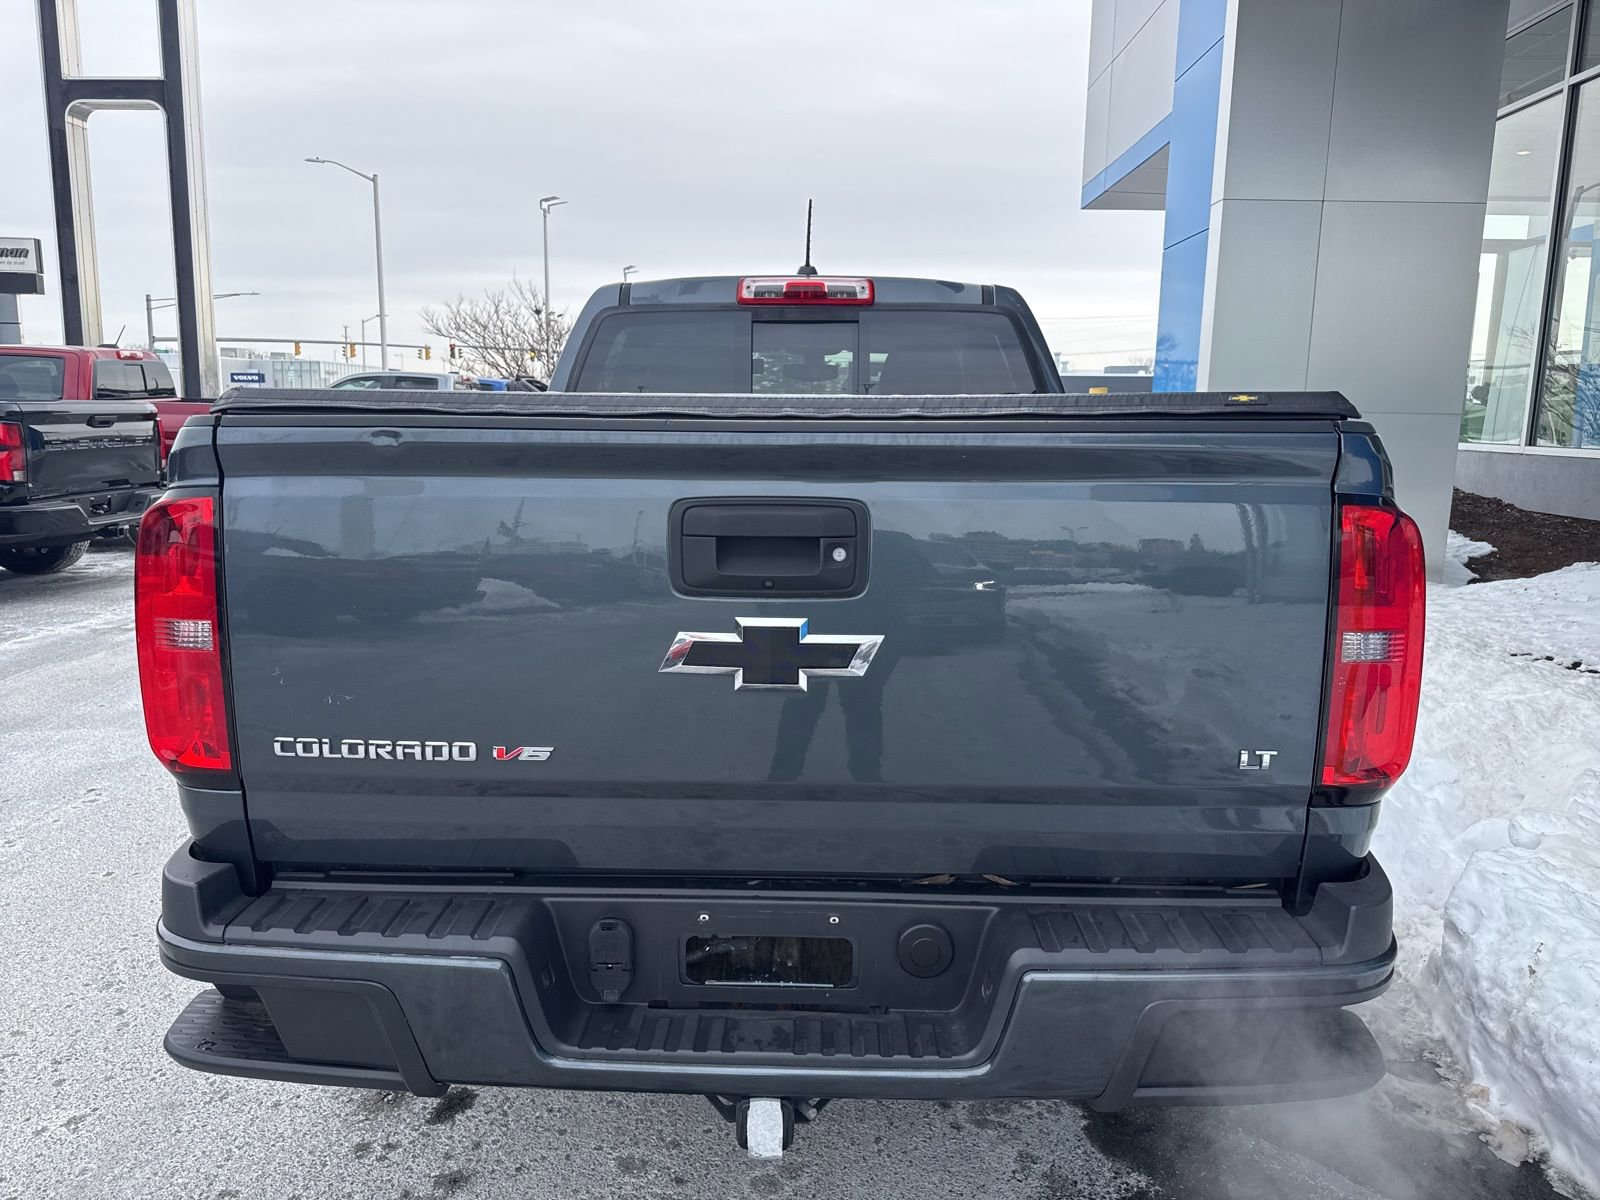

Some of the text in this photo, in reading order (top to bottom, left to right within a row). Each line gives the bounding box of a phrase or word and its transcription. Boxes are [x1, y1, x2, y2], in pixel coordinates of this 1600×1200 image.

[46, 436, 152, 451] CHEVROLET
[273, 736, 555, 763] COLORADO V6
[1239, 750, 1278, 770] LT
